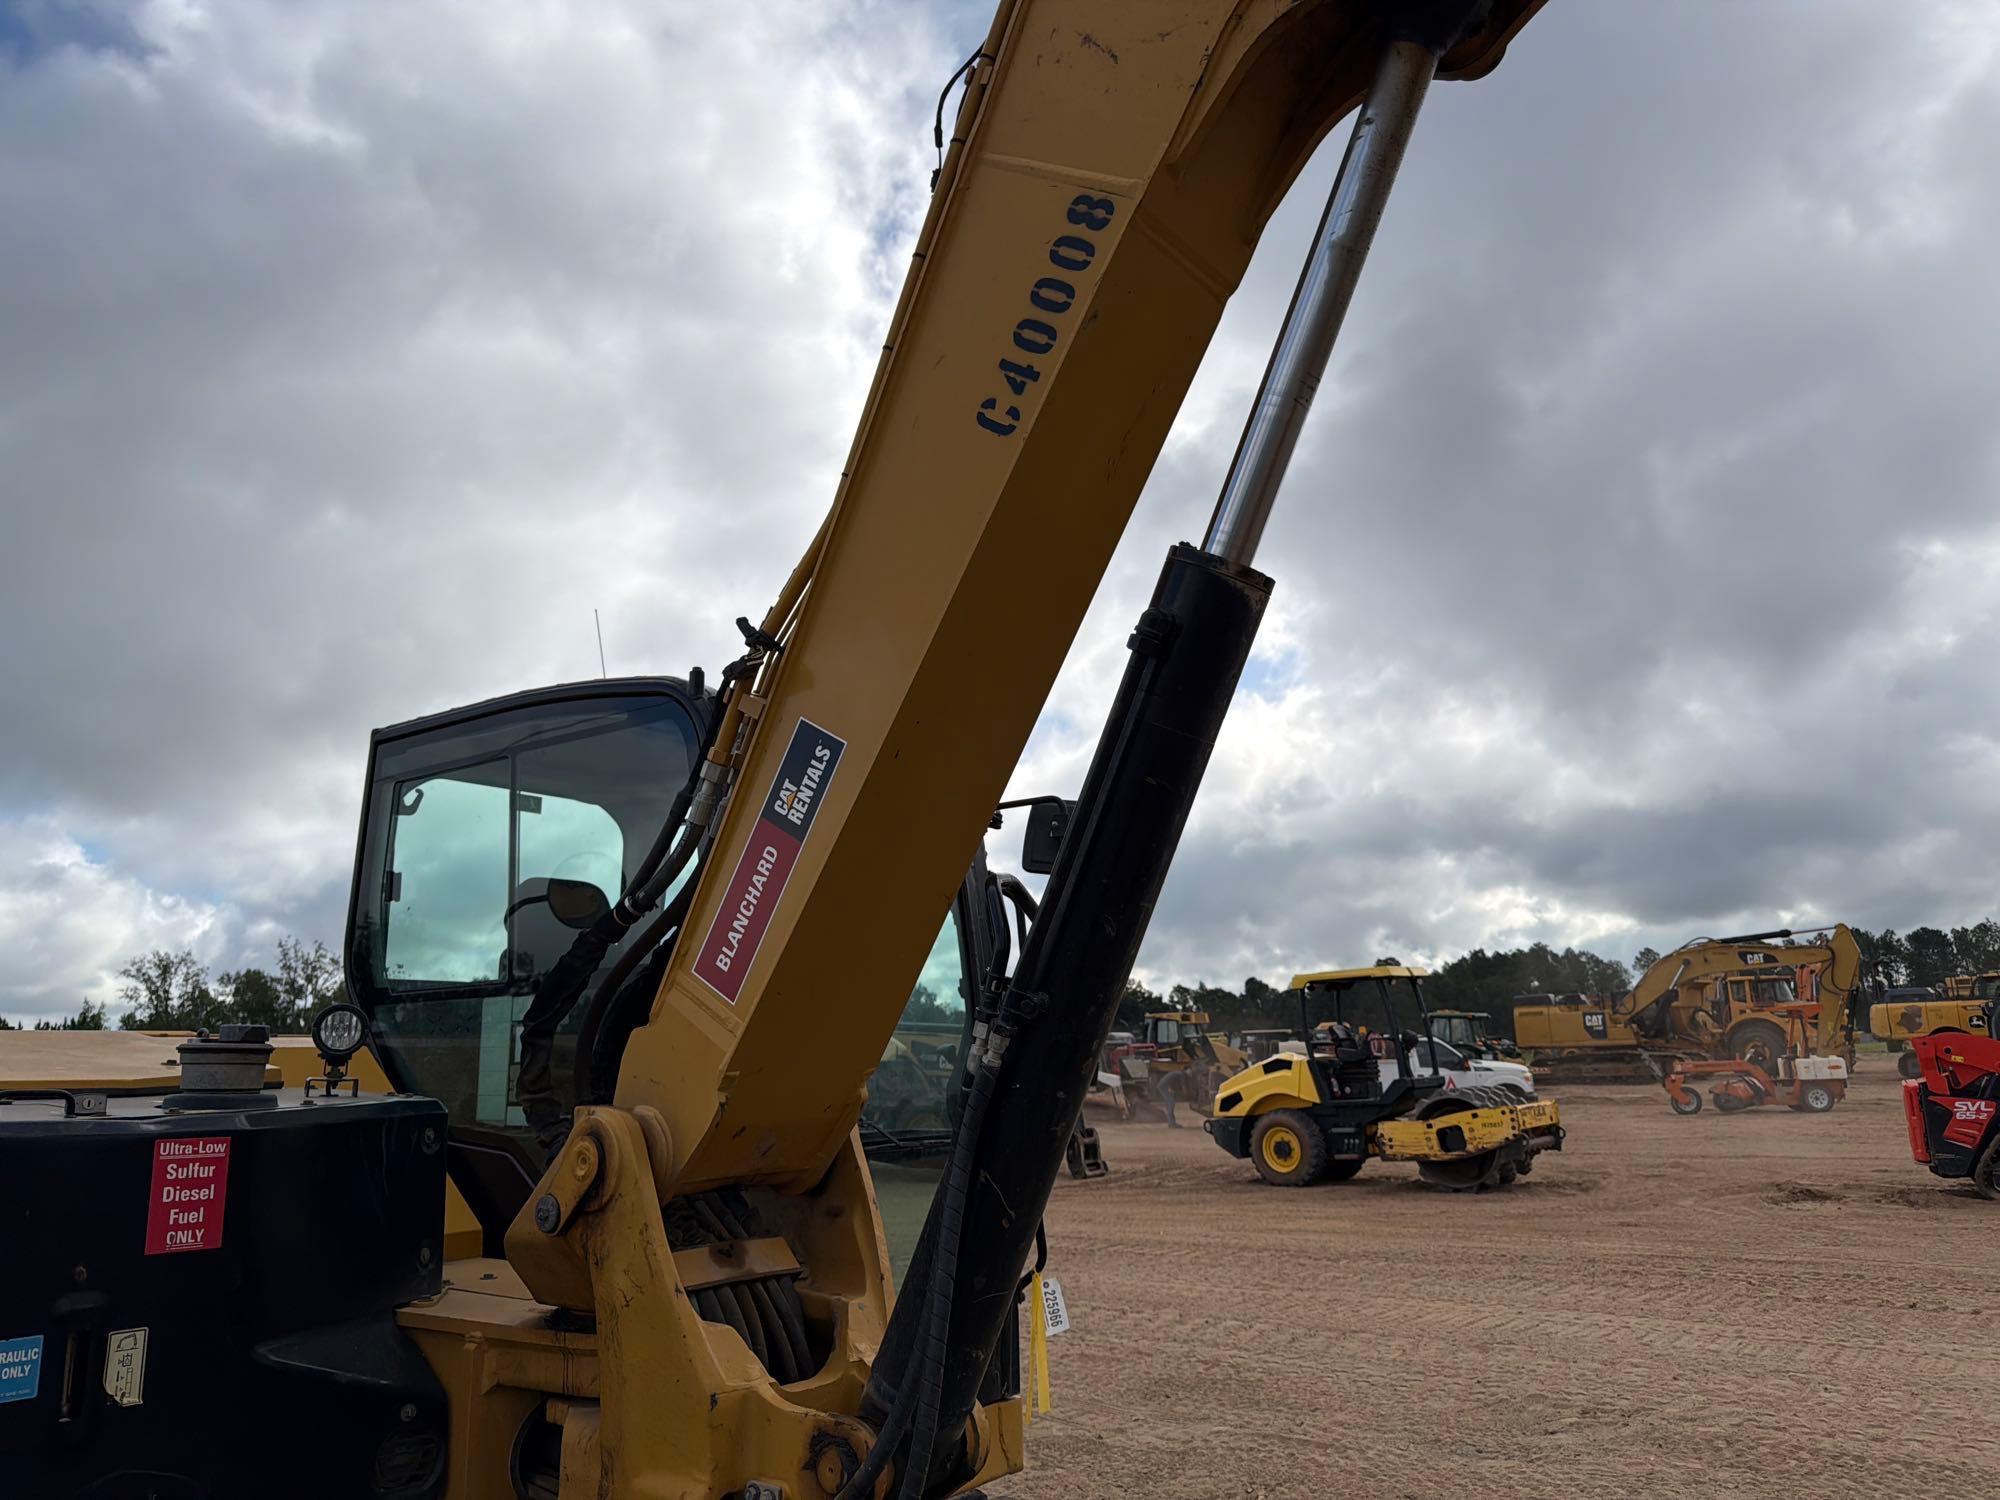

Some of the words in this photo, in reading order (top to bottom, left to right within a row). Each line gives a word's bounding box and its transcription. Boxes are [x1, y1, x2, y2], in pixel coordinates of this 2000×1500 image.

[976, 195, 1115, 436] C40008
[787, 745, 831, 825] RENTALS
[774, 778, 799, 816] CAT
[715, 845, 778, 972] BLANCHARD
[1746, 953, 1764, 965] CAT
[1585, 1014, 1603, 1026] CAT
[1953, 1101, 1994, 1111] SVL
[1955, 1111, 1988, 1120] 65-2
[160, 1141, 227, 1156] Ultra-Low
[166, 1162, 216, 1179] Sulfur
[162, 1184, 215, 1203] Diesel
[169, 1207, 204, 1225] Fuel
[166, 1228, 205, 1246] ONLY
[1044, 1289, 1063, 1328] 225966
[1, 1364, 32, 1380] ONLY
